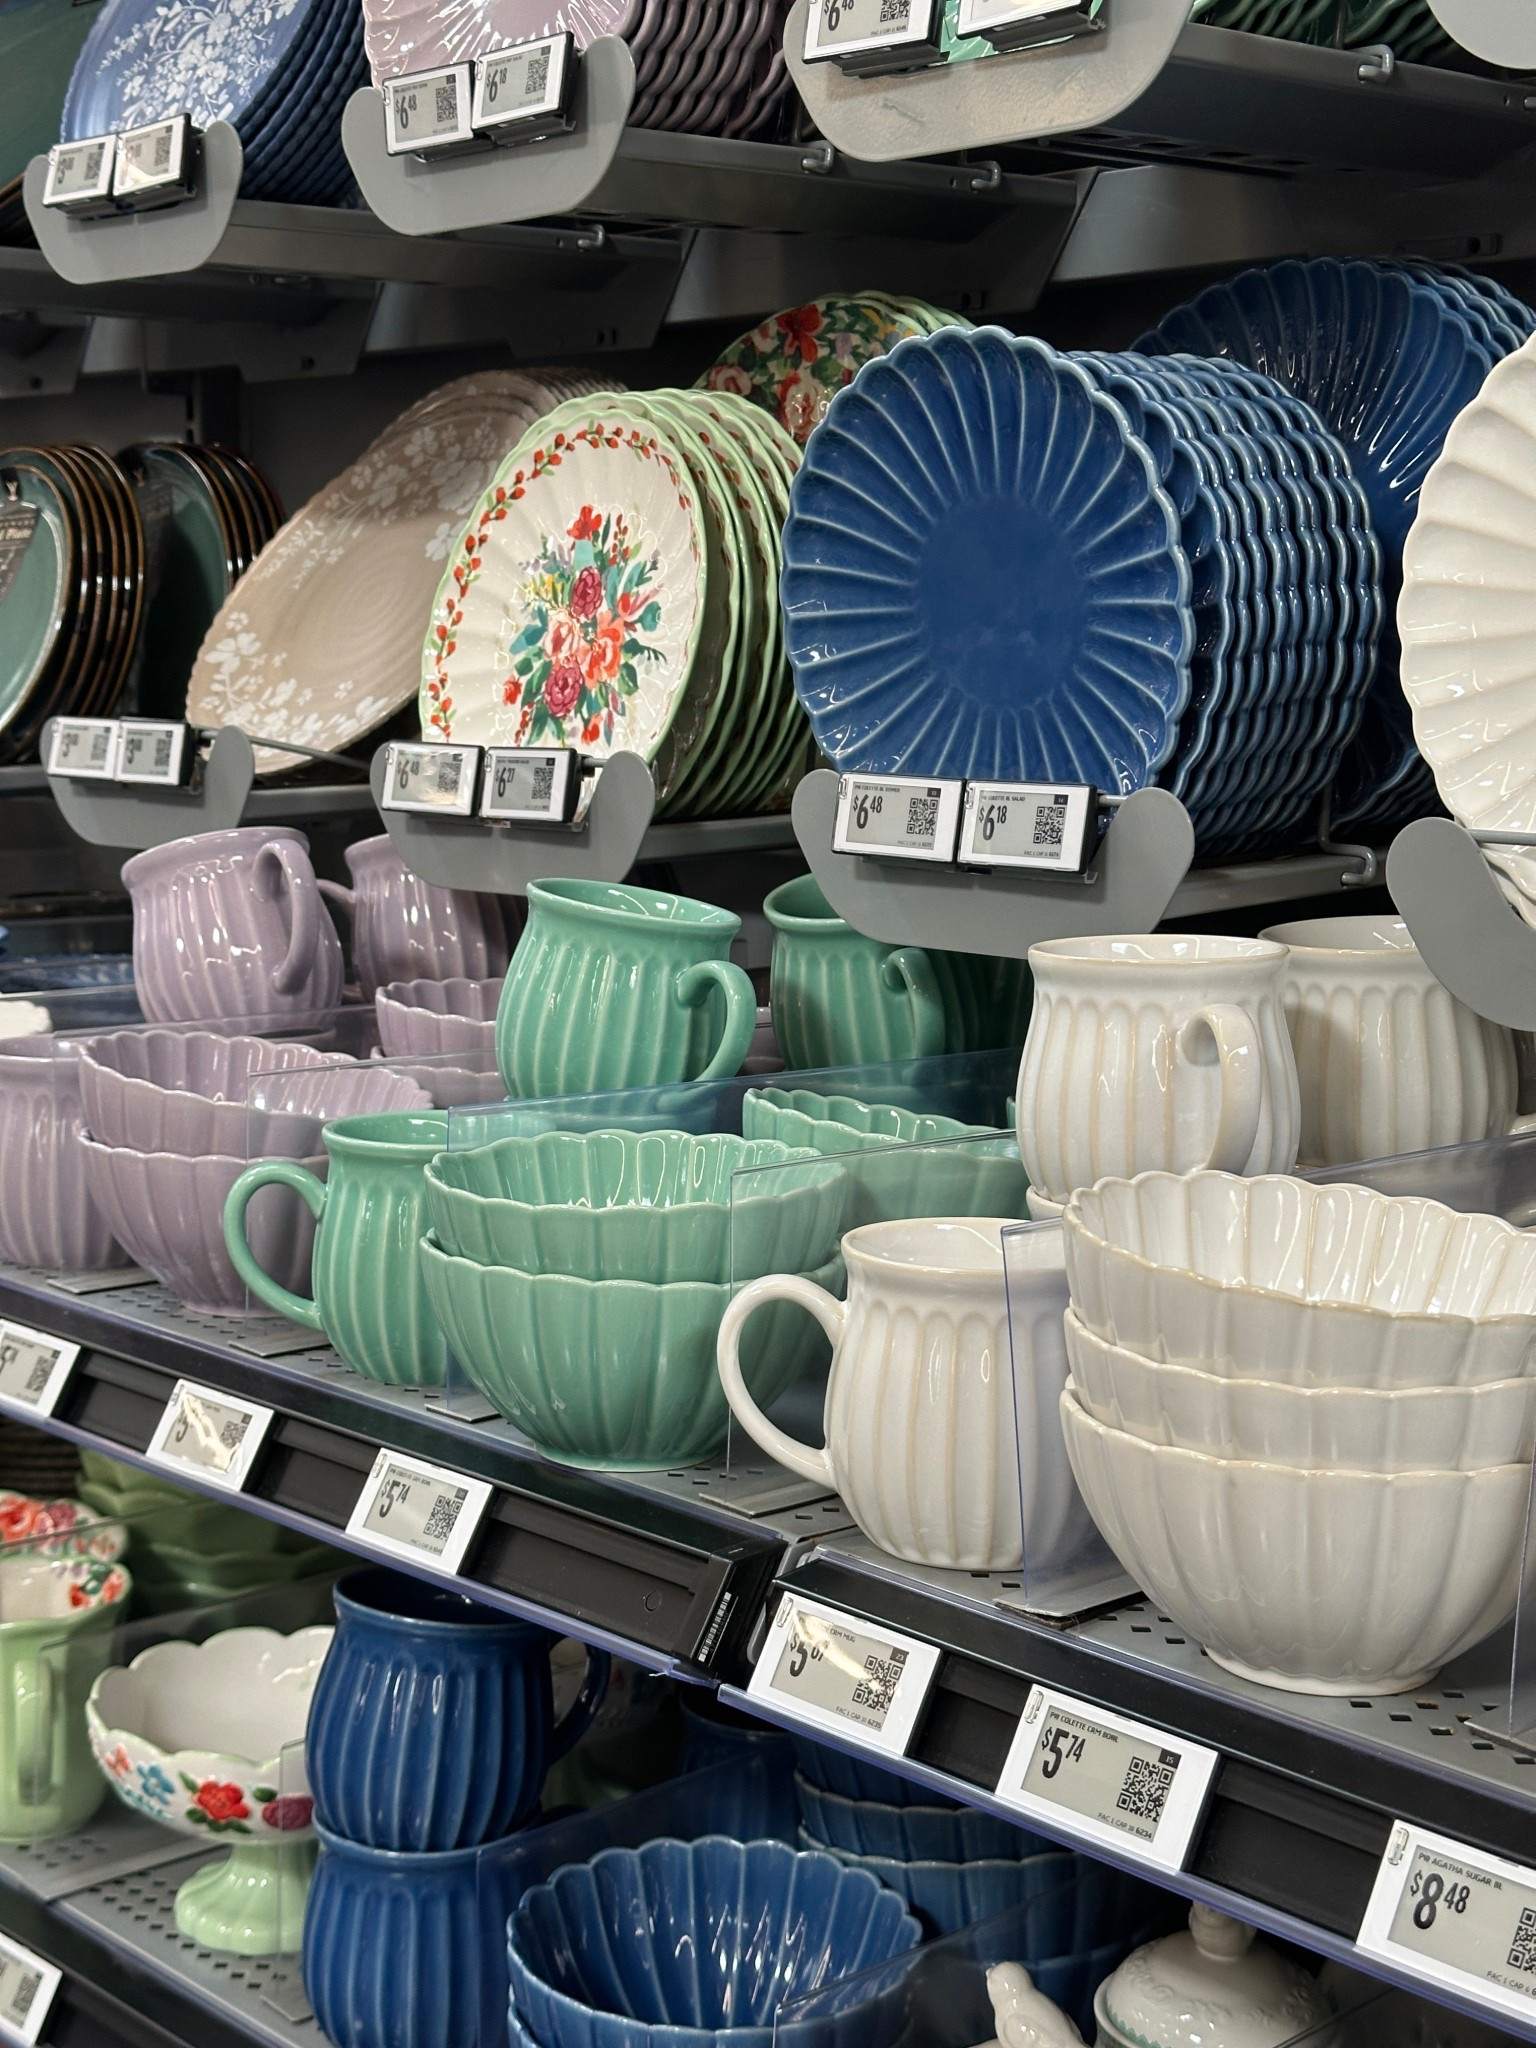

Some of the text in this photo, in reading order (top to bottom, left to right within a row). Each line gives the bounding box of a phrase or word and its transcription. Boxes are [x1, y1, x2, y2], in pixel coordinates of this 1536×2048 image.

[842, 1633, 856, 1642] MUG
[1060, 1716, 1086, 1730] COLETTE
[1086, 1725, 1101, 1736] CRM
[1102, 1731, 1118, 1742] BOWL
[1432, 1858, 1463, 1875] AGATHA
[1465, 1870, 1492, 1885] SUGAR
[1487, 1971, 1502, 1982] FAC
[1508, 1980, 1524, 1989] CAP
